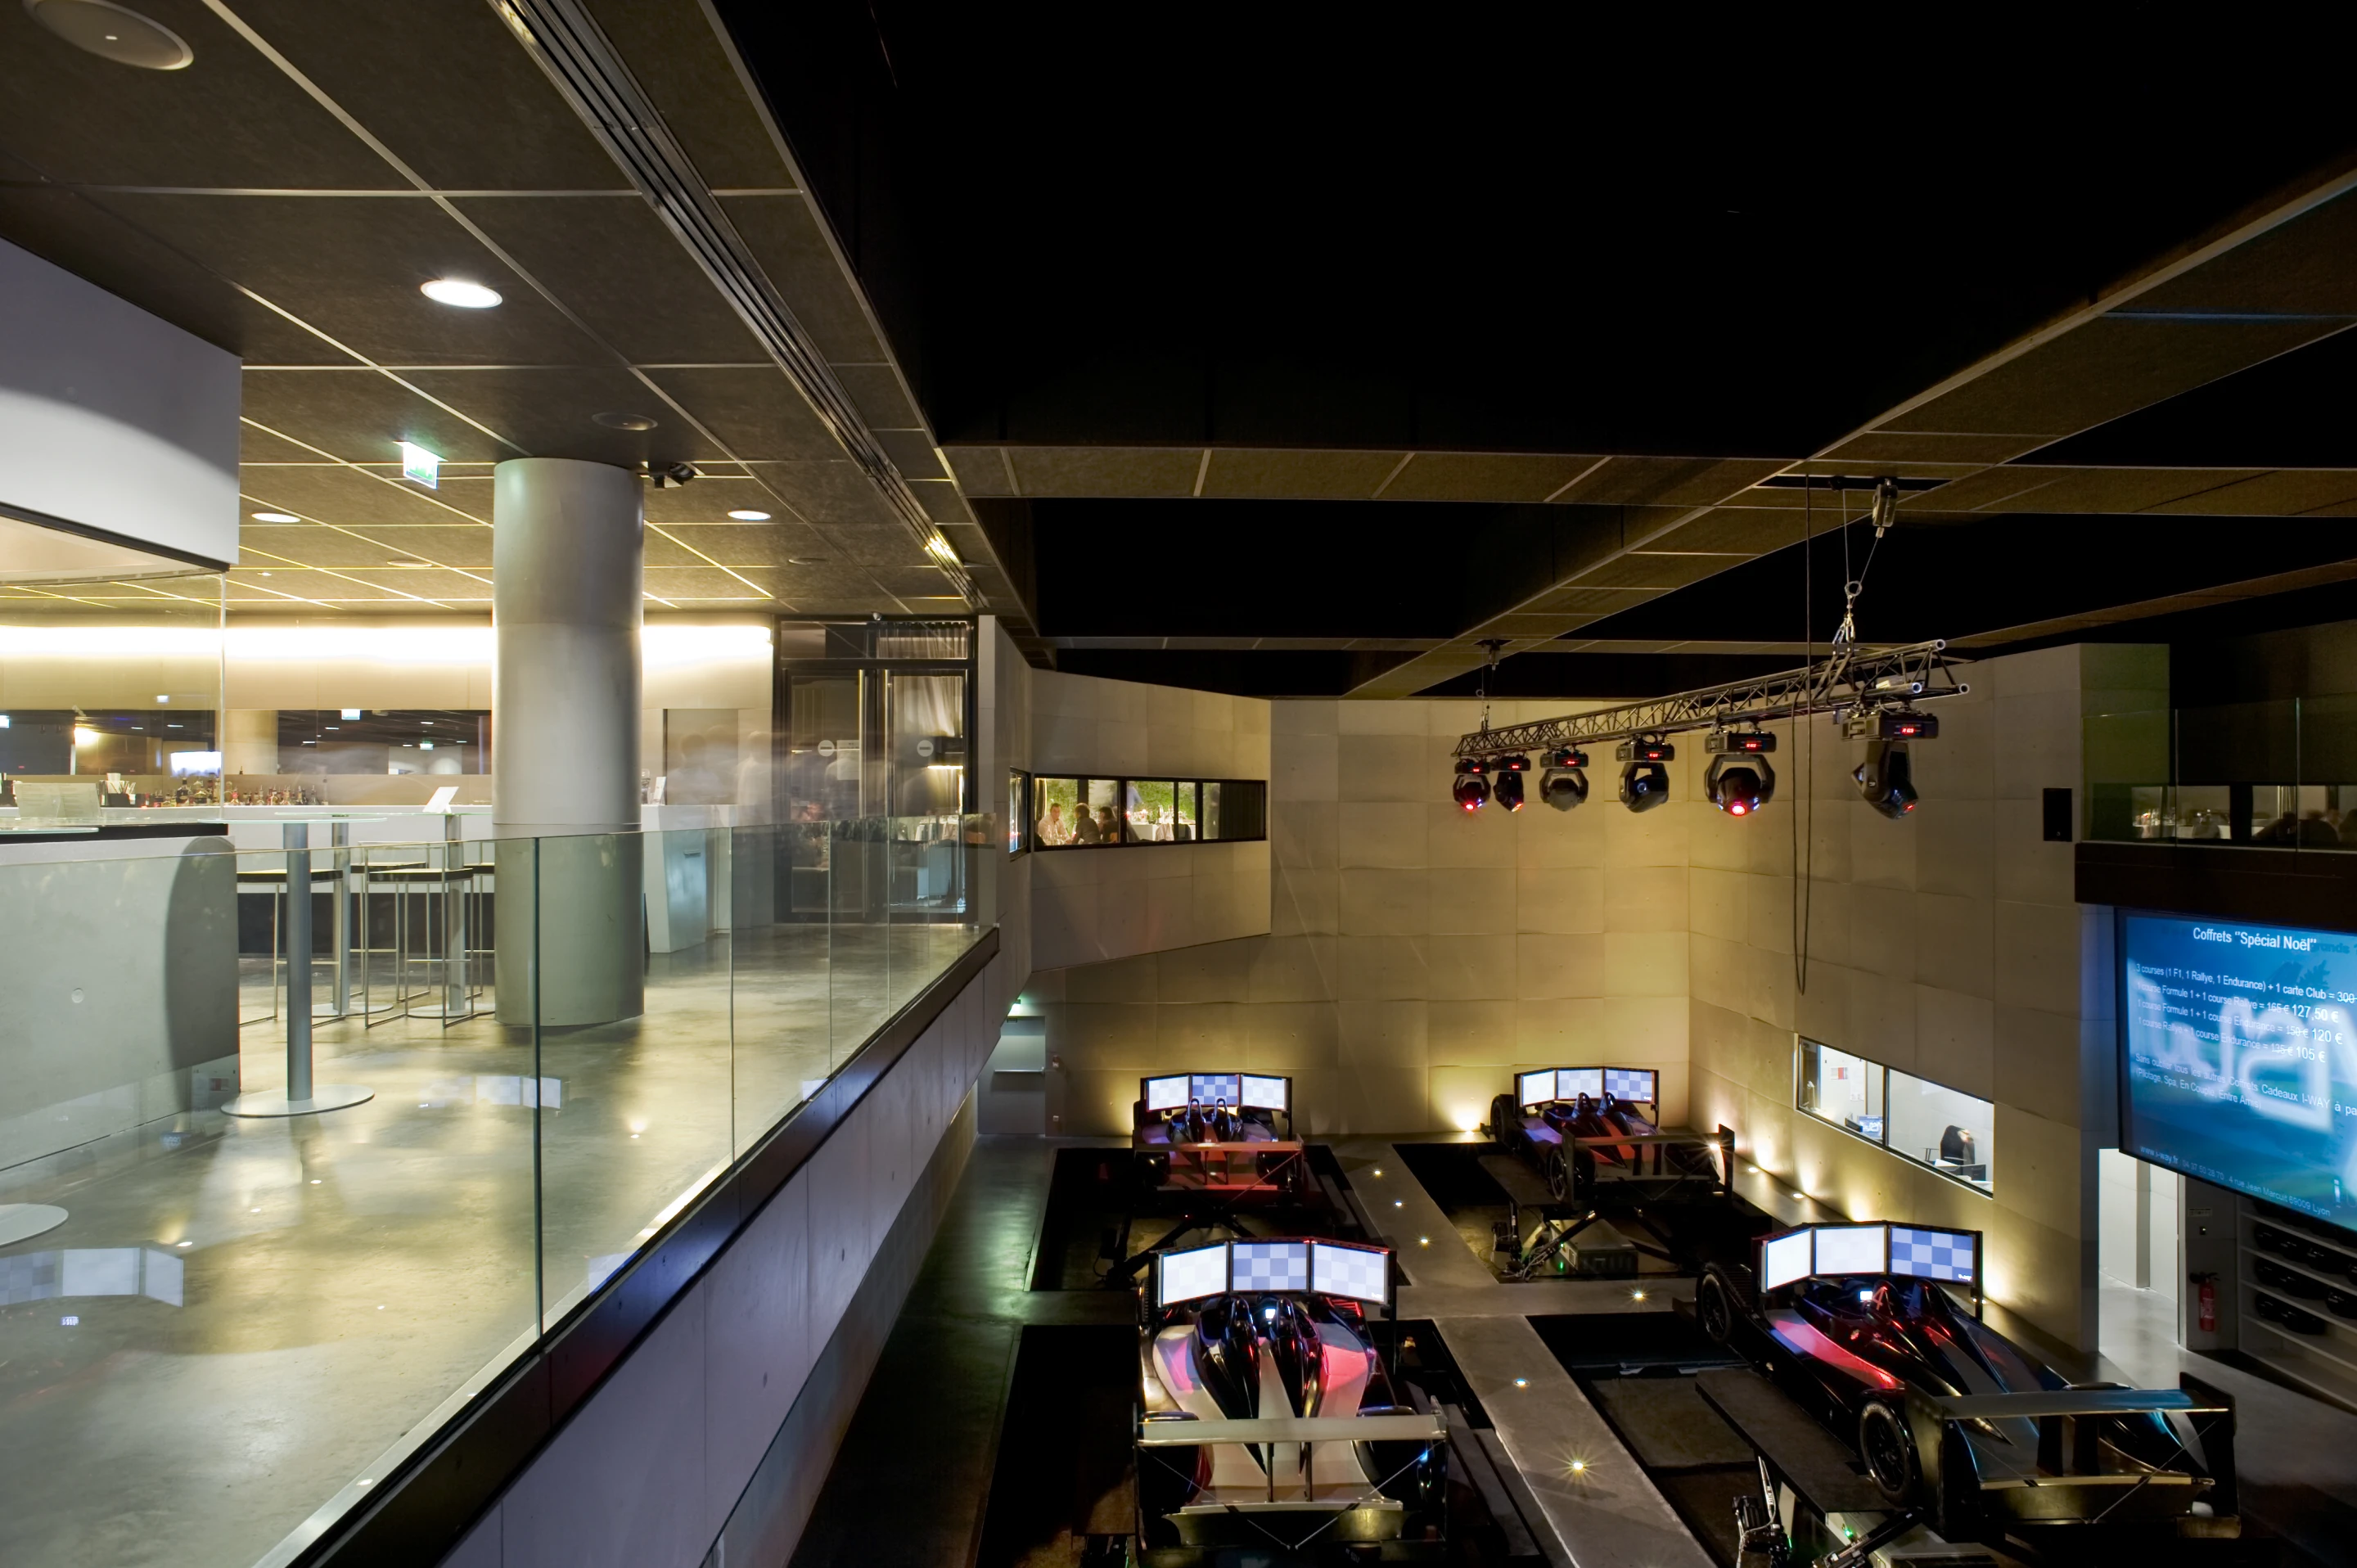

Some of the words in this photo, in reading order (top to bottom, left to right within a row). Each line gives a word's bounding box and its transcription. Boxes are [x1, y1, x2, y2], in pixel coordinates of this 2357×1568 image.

[2193, 926, 2233, 943] Coffrets
[2141, 966, 2165, 975] courses
[2165, 967, 2171, 978] (1
[2192, 971, 2215, 985] Rallye,
[2223, 975, 2266, 993] Endurance)
[2276, 983, 2281, 993] 1
[2283, 985, 2304, 996] carte
[2305, 987, 2327, 999] Club
[2141, 984, 2161, 994] course
[2162, 985, 2188, 998] Formule
[2208, 994, 2232, 1005] course
[2233, 996, 2258, 1012] Rallye
[2292, 1003, 2328, 1021] 127,50
[2331, 1011, 2339, 1023] €
[2142, 1001, 2161, 1011] course
[2162, 1003, 2188, 1016] Formule
[2208, 1013, 2233, 1024] course
[2233, 1016, 2275, 1032] Endurance
[2312, 1028, 2332, 1043] 120
[2335, 1032, 2343, 1045] €
[2142, 1019, 2161, 1029] course
[2195, 1030, 2220, 1041] course
[2220, 1033, 2260, 1049] Endurance
[2296, 1046, 2315, 1061] 105
[2318, 1051, 2326, 1063] €
[2135, 1053, 2150, 1064] Sans
[2229, 1076, 2259, 1092] Coffrets
[2261, 1084, 2298, 1102] Cadeaux
[2301, 1093, 2331, 1109] I-WAY
[2334, 1101, 2341, 1112] à
[2179, 1079, 2189, 1090] En
[2219, 1089, 2238, 1102] Entre
[2246, 1182, 2261, 1193] Jean
[2312, 1203, 2331, 1217] Lyon
[1872, 1286, 1887, 1311] 4
